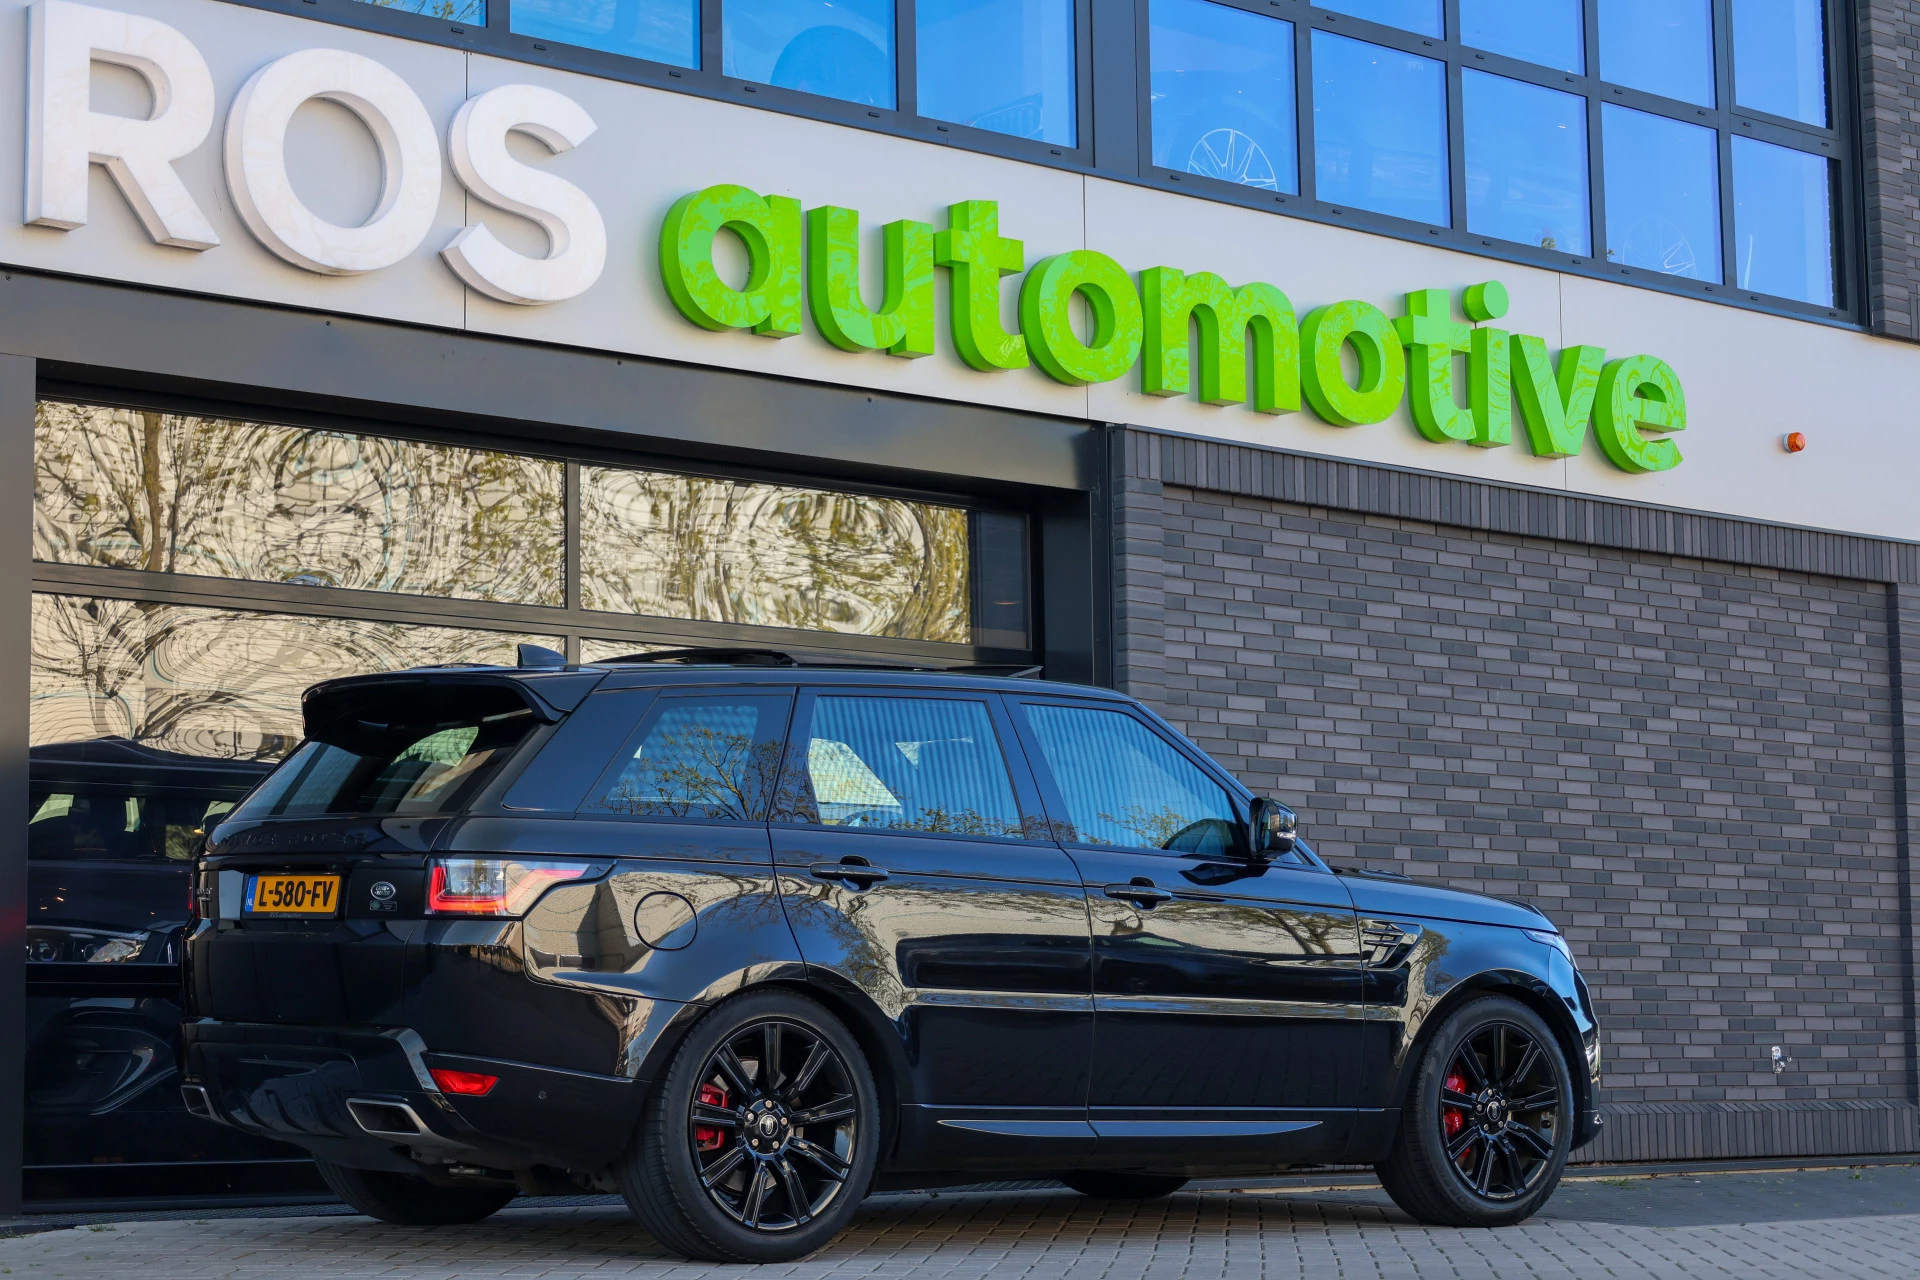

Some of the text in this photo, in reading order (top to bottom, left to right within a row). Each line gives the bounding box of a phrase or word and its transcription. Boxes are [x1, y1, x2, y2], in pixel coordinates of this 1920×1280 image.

[24, 0, 1687, 473] ROS automotive
[258, 881, 334, 907] L-580-FV
